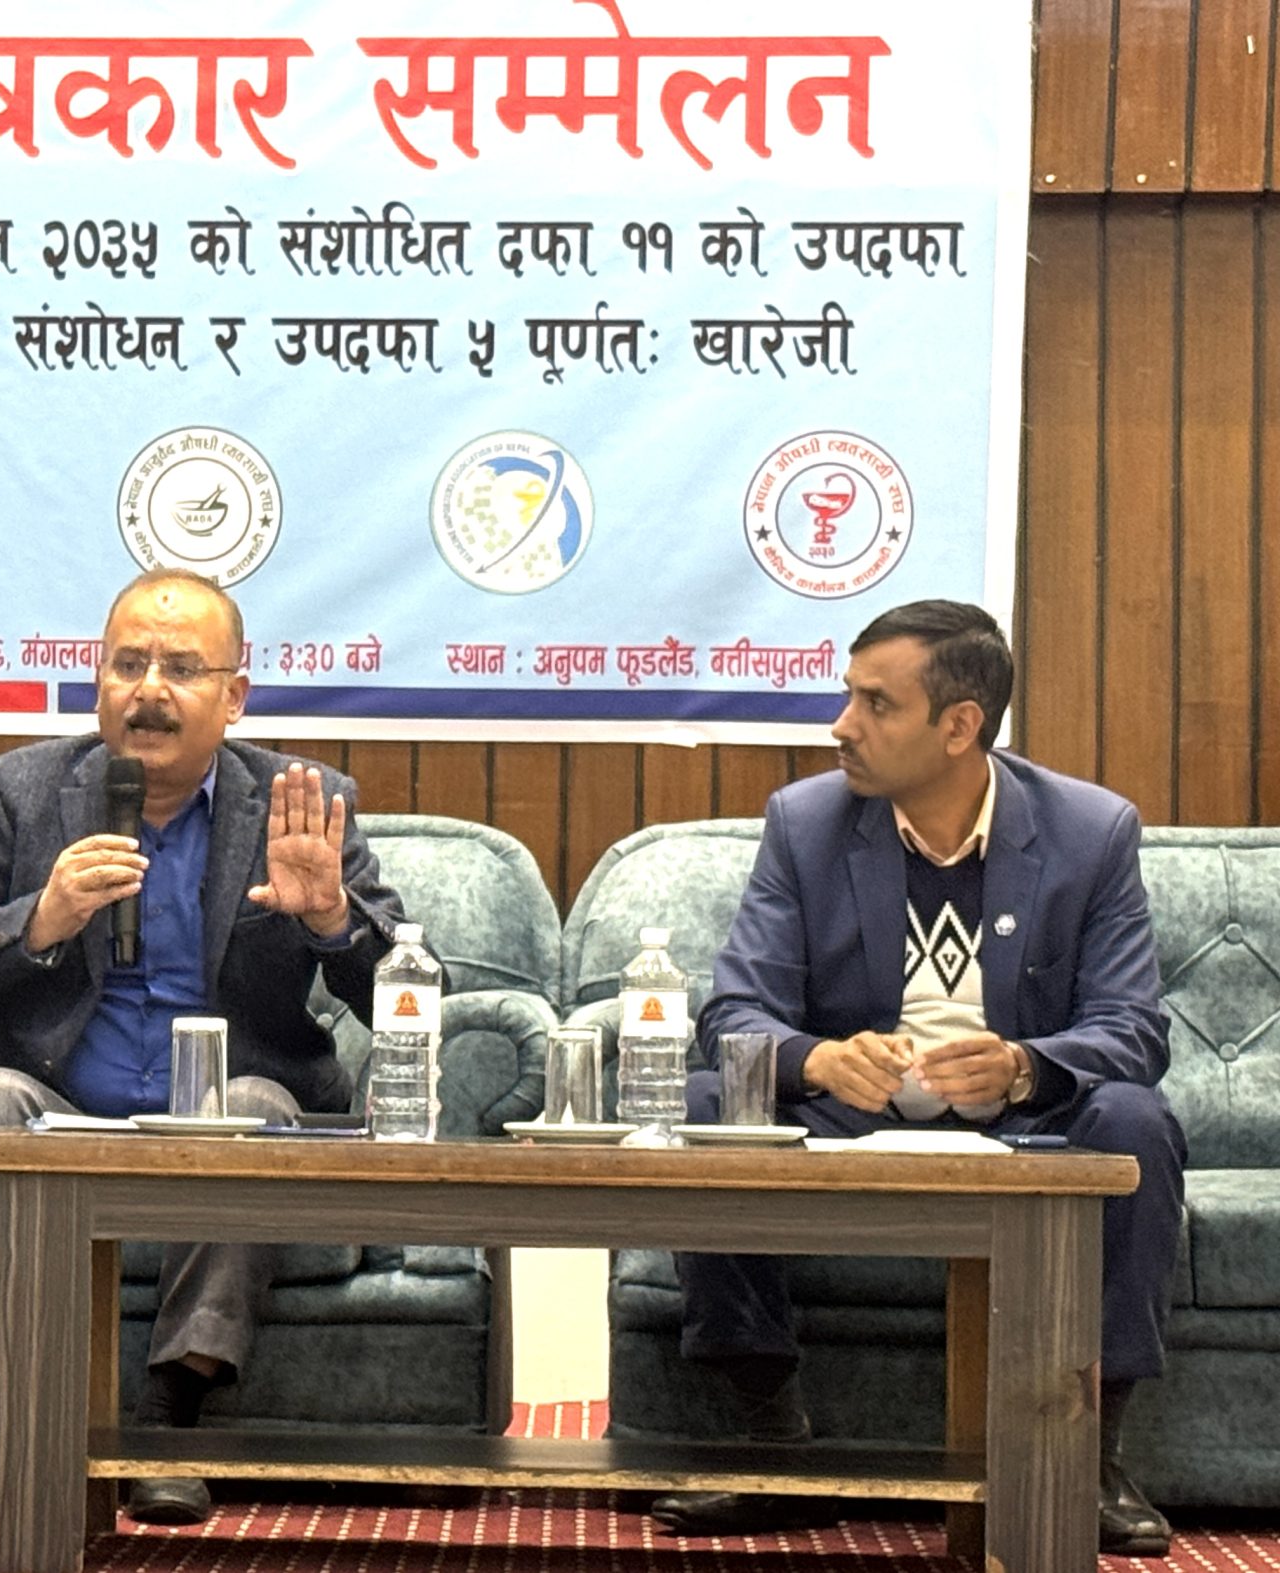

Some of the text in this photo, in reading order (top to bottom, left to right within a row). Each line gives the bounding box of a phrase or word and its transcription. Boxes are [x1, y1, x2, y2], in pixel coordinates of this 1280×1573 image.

[356, 0, 892, 170] सम्मेलन
[42, 219, 158, 280] २०३५
[187, 205, 256, 276] को
[278, 201, 473, 277] संशोधित
[497, 221, 597, 278] दफा
[622, 221, 674, 273] ११
[699, 206, 768, 277] को
[791, 221, 968, 279] उपदफा
[12, 301, 188, 371] संशोधन
[209, 316, 246, 376] र
[271, 317, 442, 374] उपदफा
[468, 320, 495, 378] ५
[690, 301, 858, 379] खारेजी
[20, 632, 104, 671] मंगलबा
[345, 633, 383, 673] बजे
[445, 643, 507, 675] स्थान
[533, 645, 609, 686] अनुपम
